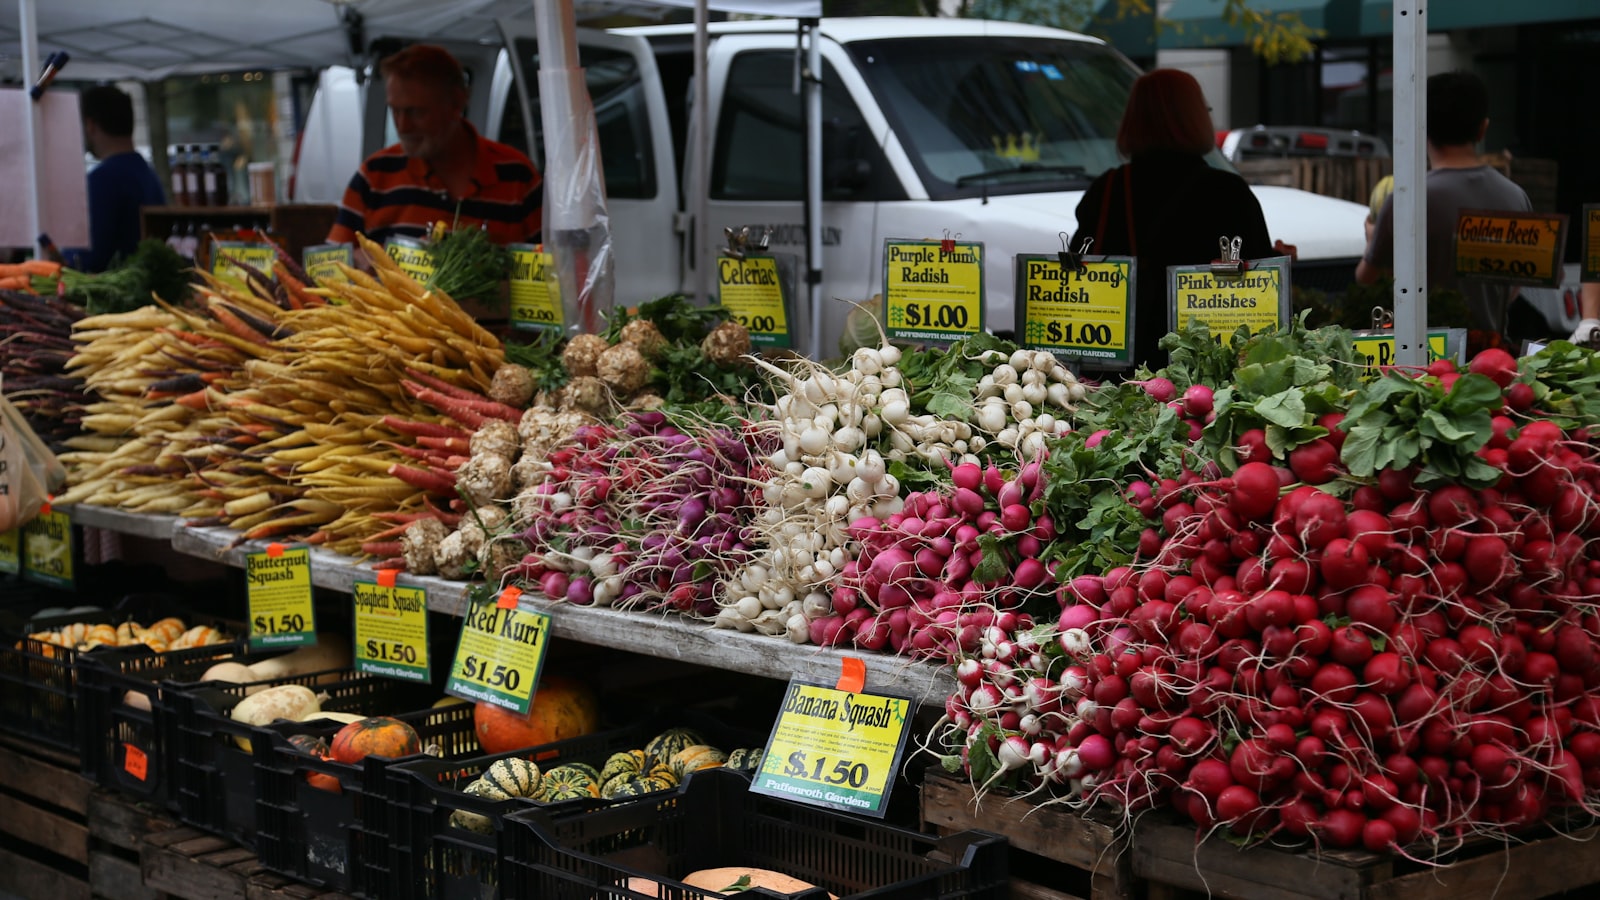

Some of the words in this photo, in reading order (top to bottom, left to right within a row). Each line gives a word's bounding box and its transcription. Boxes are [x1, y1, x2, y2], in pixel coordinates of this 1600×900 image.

[1460, 217, 1504, 242] Golden
[1505, 220, 1540, 246] Beets
[890, 246, 934, 266] Purple
[938, 247, 975, 263] Plum
[1479, 257, 1537, 277] $2.00
[720, 260, 776, 286] Celeriac
[902, 266, 949, 283] Radish
[1029, 263, 1070, 286] Ping
[1074, 265, 1120, 288] Pong
[1177, 275, 1212, 289] Pink
[1029, 285, 1089, 304] Radish
[1187, 294, 1256, 309] Radishes
[517, 308, 554, 321] $2.00
[905, 303, 968, 329] $1.00
[1046, 320, 1112, 346] $1.00
[1082, 350, 1116, 358] GARDENS
[247, 551, 307, 570] Butternut
[248, 567, 294, 585] Squash
[354, 584, 389, 614] Spaghetti
[392, 588, 420, 616] Squash
[254, 614, 305, 634] $1.50
[464, 600, 500, 634] Red
[499, 608, 542, 646] Kuri
[366, 639, 416, 664] $1.50
[462, 655, 520, 691] $1.50
[784, 684, 839, 721] Banana
[839, 693, 893, 732] Squash
[764, 779, 824, 799] Paffenroth
[824, 791, 871, 809] Gardens
